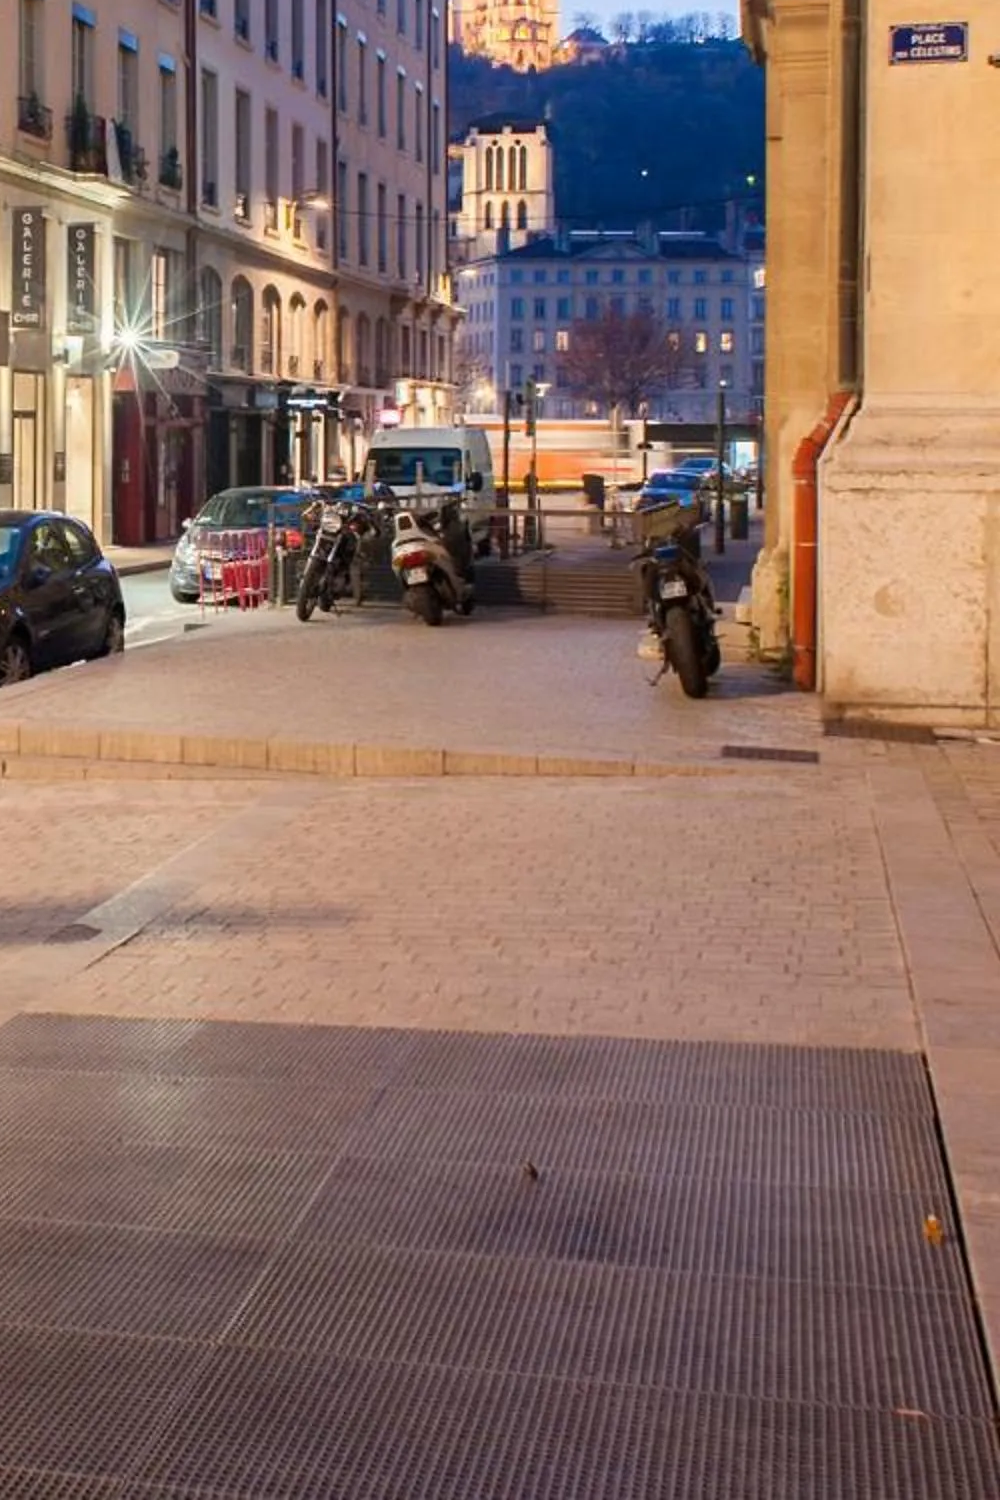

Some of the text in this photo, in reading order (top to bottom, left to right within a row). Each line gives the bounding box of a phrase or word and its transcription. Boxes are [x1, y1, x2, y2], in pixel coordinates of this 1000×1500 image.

[911, 33, 946, 45] PLACE
[21, 213, 33, 307] GALERIE
[75, 228, 86, 315] GALERIE
